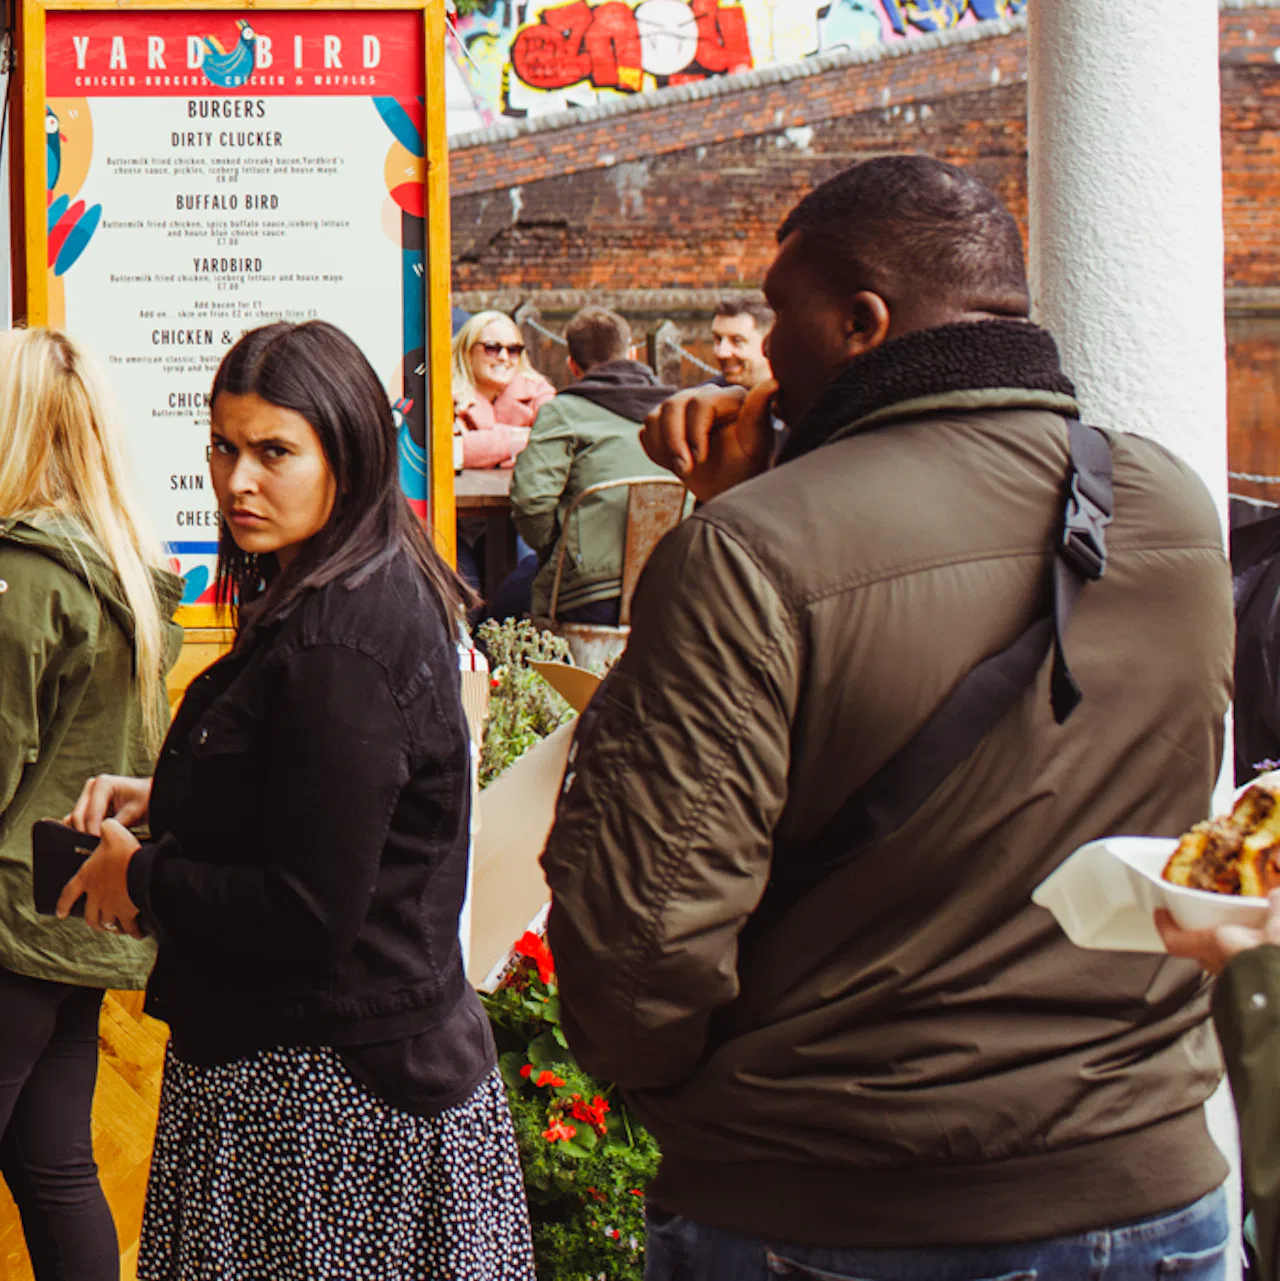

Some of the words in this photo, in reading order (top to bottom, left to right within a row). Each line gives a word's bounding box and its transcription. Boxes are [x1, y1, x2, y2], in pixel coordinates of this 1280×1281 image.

[72, 35, 205, 69] YARD
[256, 35, 381, 69] BIRD
[75, 76, 135, 86] CHICKEN
[145, 76, 214, 87] BURGERS,
[225, 76, 284, 86] CHICKEN
[295, 76, 303, 85] &
[314, 75, 376, 85] WAFFLES
[188, 99, 265, 118] BURGERS
[172, 132, 212, 147] DIRTY
[220, 131, 282, 147] CLUCKER
[107, 157, 148, 165] Buttermilk
[151, 157, 171, 165] fried
[211, 157, 241, 165] smoked
[244, 157, 273, 166] streaky
[176, 194, 237, 210] BUFFALO
[245, 194, 278, 210] BIRD
[102, 220, 144, 228] Buttermilk
[147, 220, 167, 228] fried
[169, 220, 203, 230] chicken,
[206, 221, 227, 230] spicy
[230, 220, 259, 228] buffalo
[193, 258, 262, 273] YARDBIRD
[110, 274, 152, 282] Buttermilk
[155, 274, 174, 282] fried
[177, 274, 210, 282] chicken,
[214, 274, 245, 283] iceberg
[248, 274, 276, 282] lettuce
[194, 301, 209, 309] Add
[211, 301, 235, 310] bacon
[238, 301, 250, 310] for
[253, 300, 262, 309] £1
[140, 310, 154, 318] Add
[178, 310, 195, 318] skin
[210, 310, 229, 318] fries
[255, 310, 281, 320] cheesy
[284, 310, 305, 319] fries
[152, 329, 213, 345] CHICKEN
[221, 330, 233, 344] &
[109, 355, 122, 363] The
[163, 366, 184, 374] syrup
[188, 364, 202, 372] and
[152, 409, 194, 417] Buttermilk
[171, 475, 203, 490] SKIN
